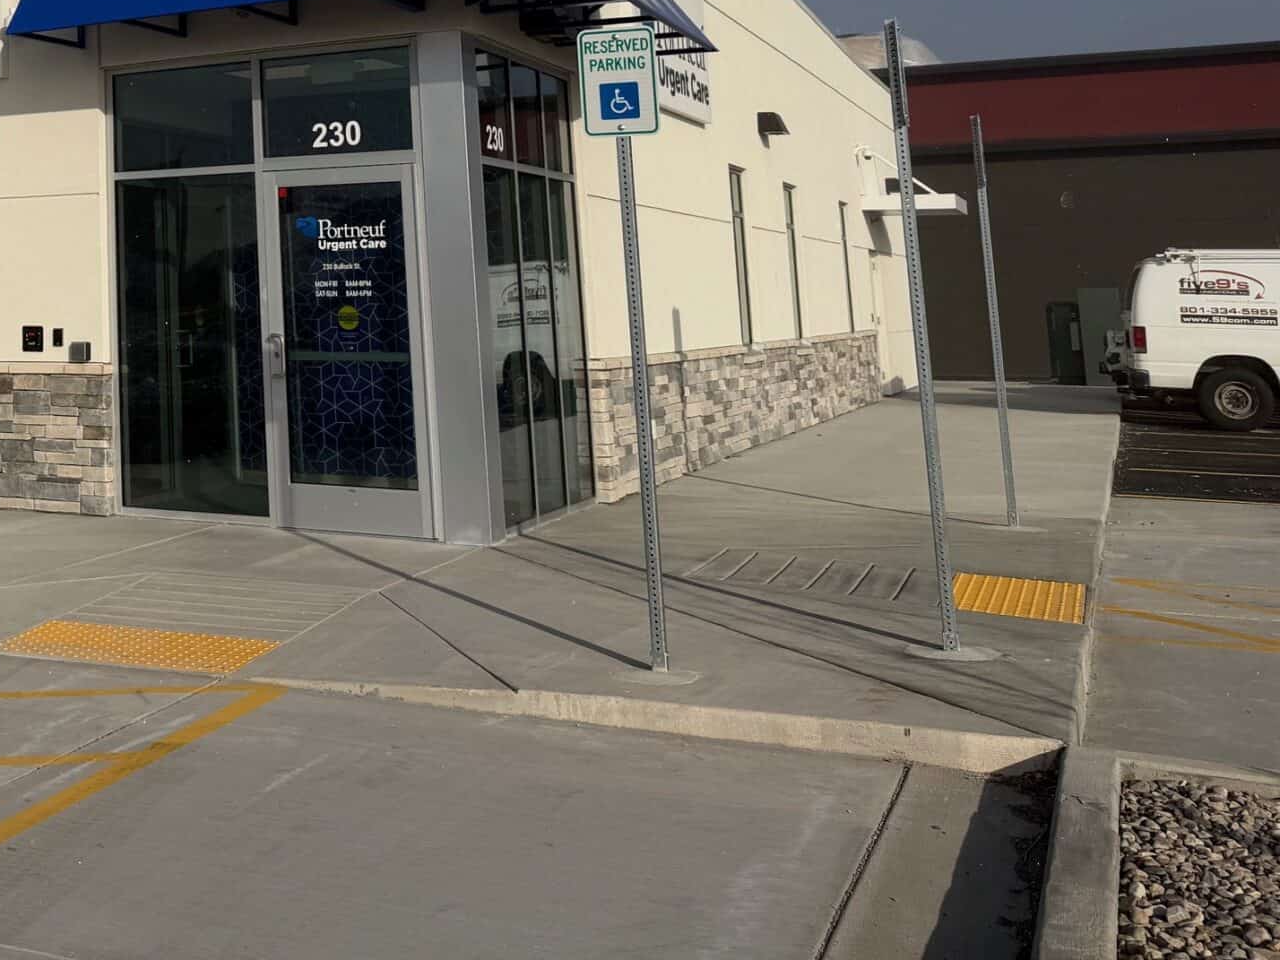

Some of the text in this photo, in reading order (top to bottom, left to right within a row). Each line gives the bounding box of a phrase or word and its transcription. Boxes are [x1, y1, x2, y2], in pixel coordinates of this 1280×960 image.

[584, 38, 649, 55] RESERVED
[589, 56, 646, 73] PARKING
[657, 56, 710, 106] Urgent Care
[312, 120, 361, 149] 230
[486, 124, 504, 152] 230
[317, 218, 387, 240] Portneuf
[318, 238, 387, 252] Urgent Care
[1179, 278, 1249, 289] five9's
